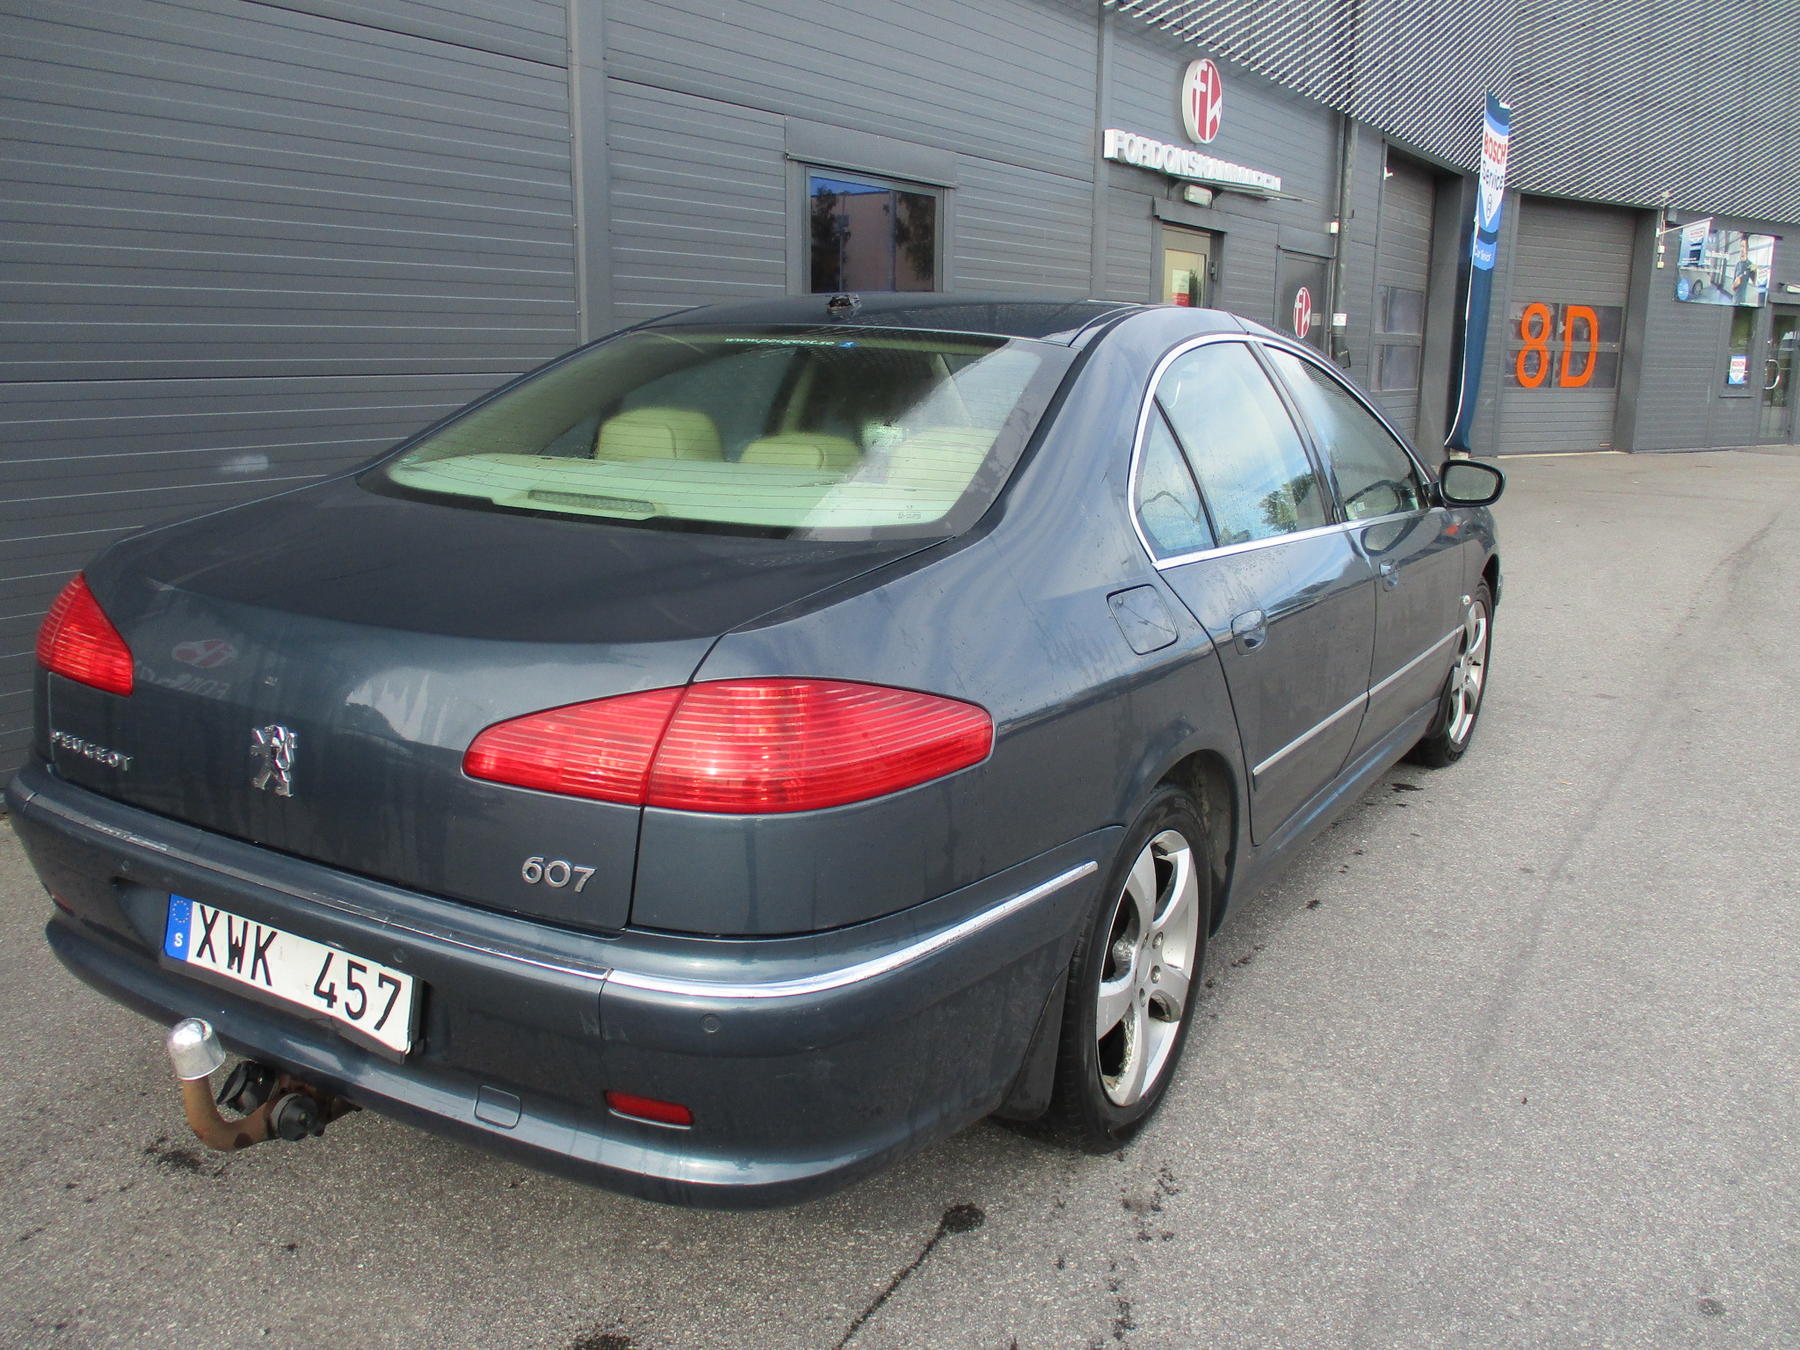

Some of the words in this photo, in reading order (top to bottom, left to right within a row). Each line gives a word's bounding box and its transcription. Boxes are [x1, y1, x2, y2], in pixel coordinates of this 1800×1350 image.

[1484, 131, 1508, 164] BOSCH
[1482, 160, 1504, 191] Service
[1516, 302, 1598, 389] 8D
[522, 856, 596, 893] 607
[174, 933, 184, 948] S
[196, 904, 278, 987] XWK
[313, 952, 402, 1031] 457
